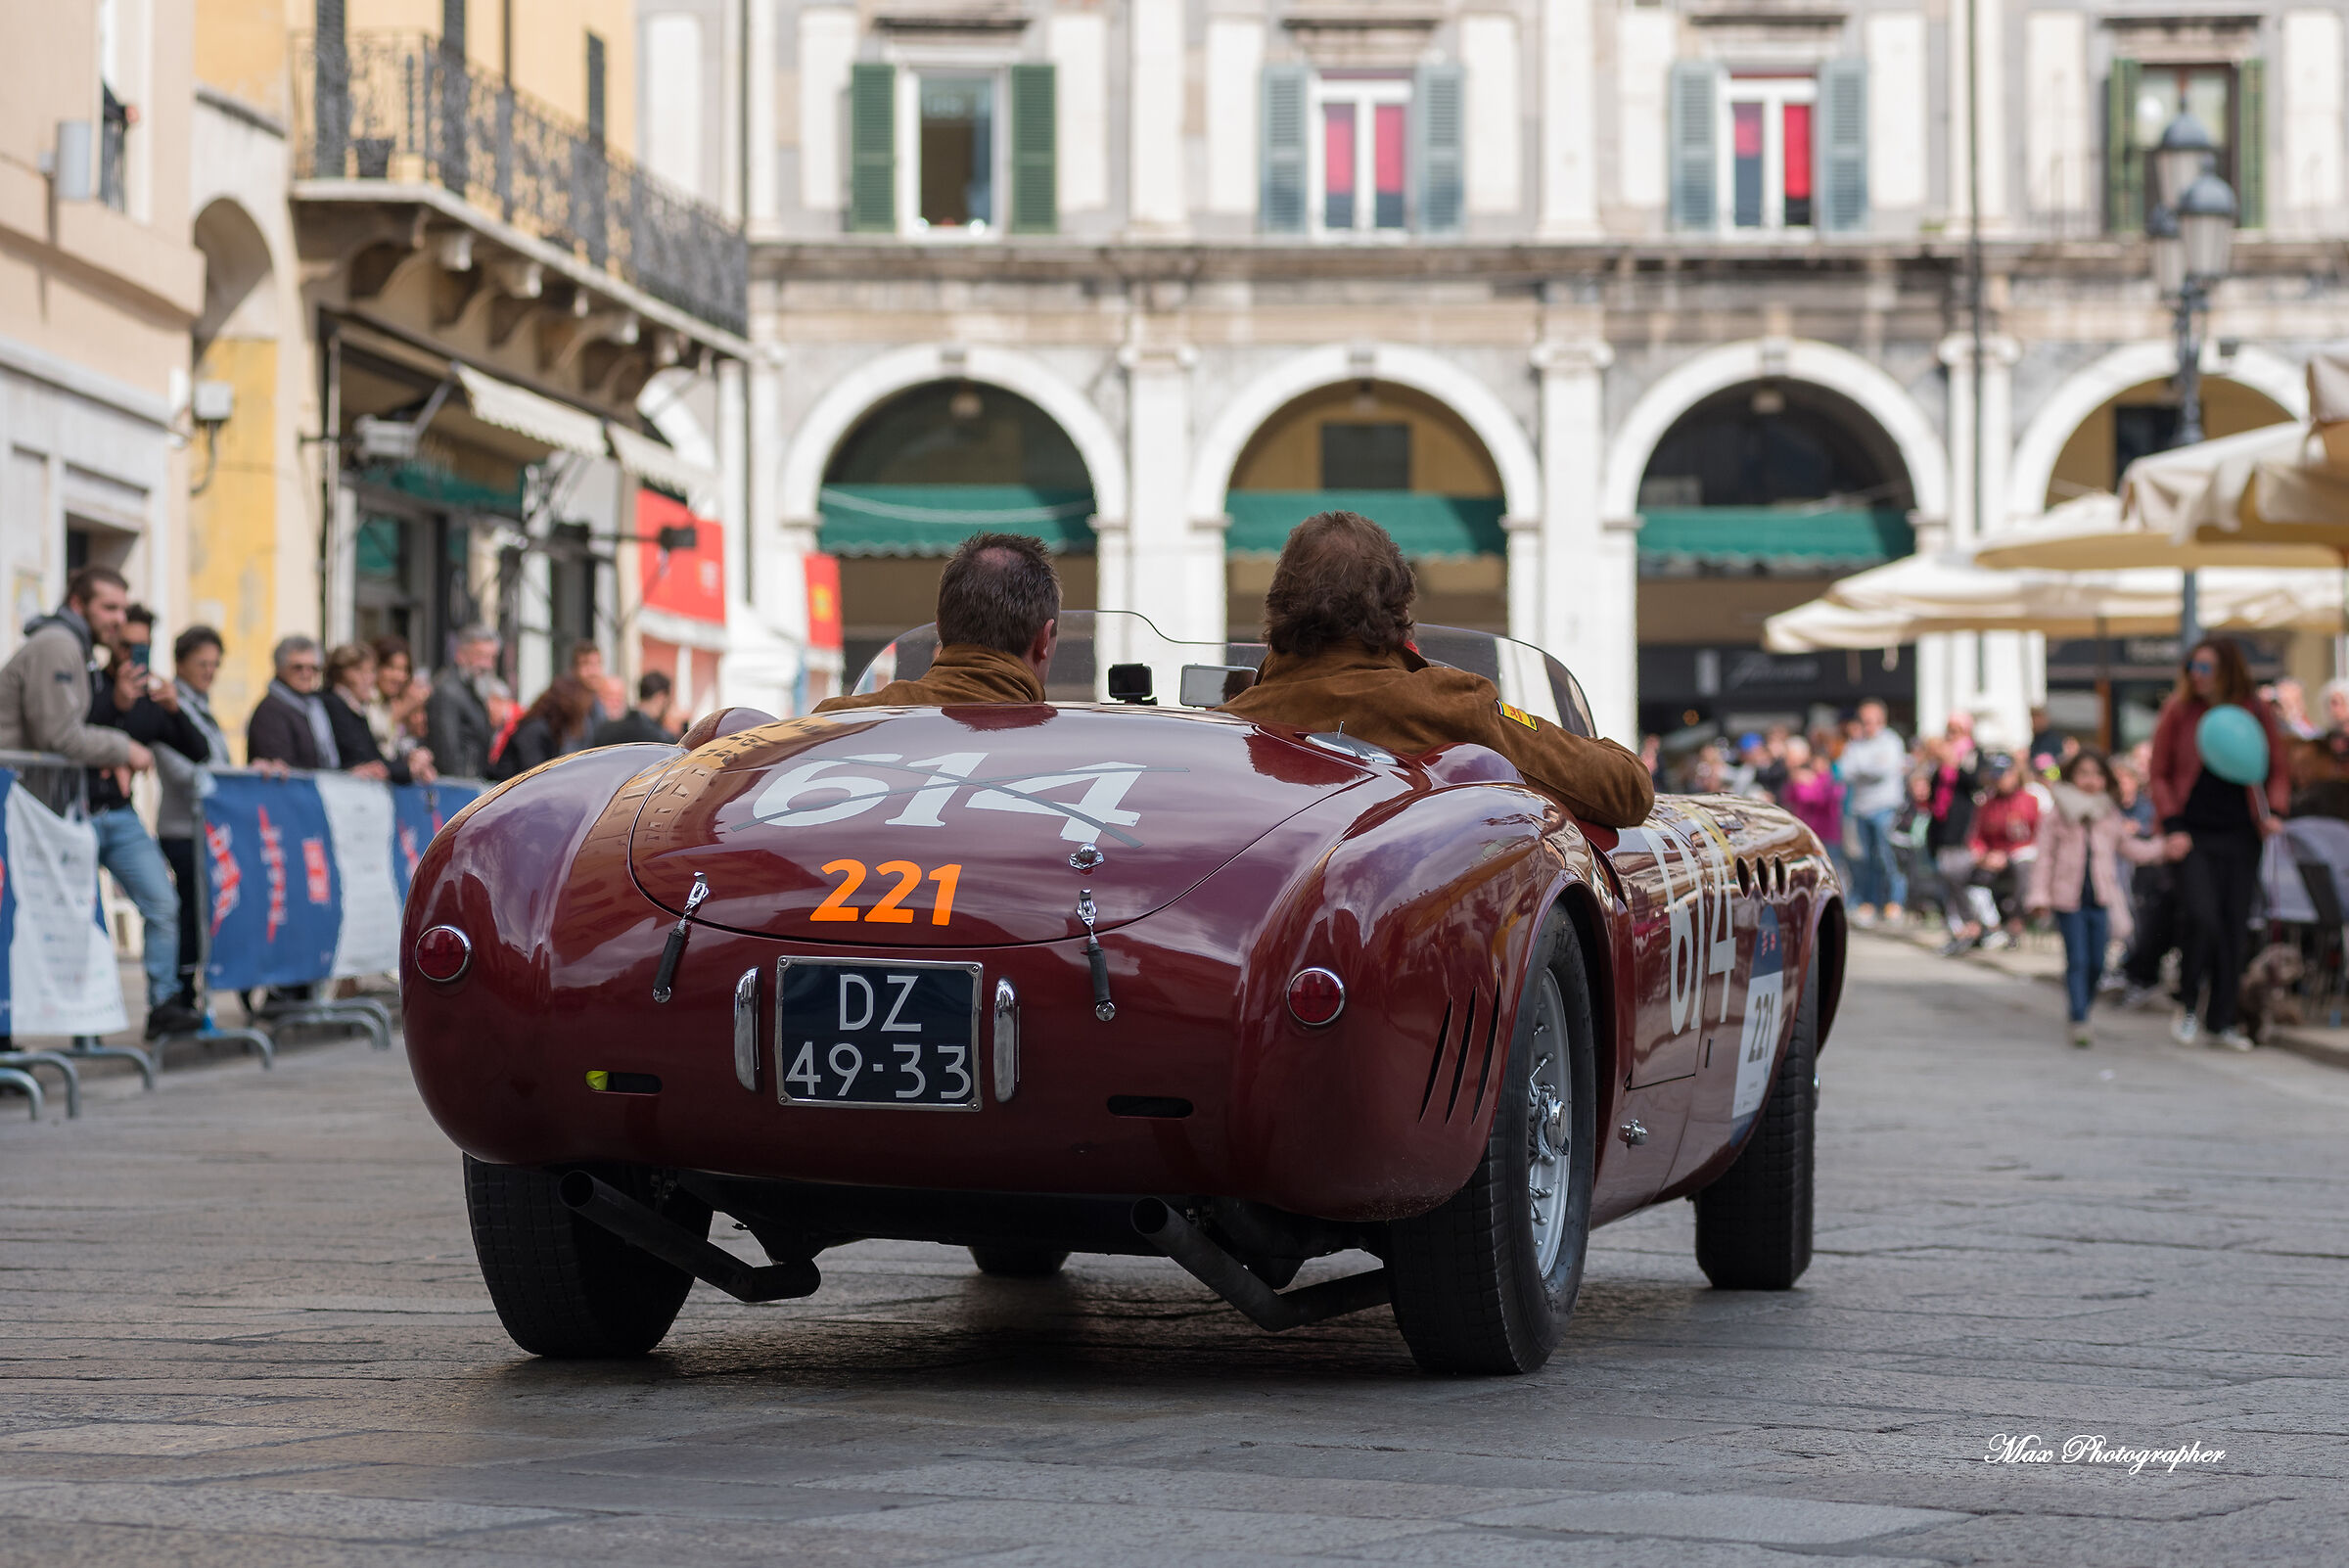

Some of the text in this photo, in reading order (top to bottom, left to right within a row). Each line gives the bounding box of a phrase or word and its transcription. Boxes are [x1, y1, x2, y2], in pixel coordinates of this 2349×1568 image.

[753, 752, 1147, 844] 614
[810, 858, 962, 927] 221
[1641, 818, 1737, 1036] 614
[840, 974, 922, 1032] DZ
[1747, 992, 1775, 1064] 221
[785, 1041, 972, 1099] 49-33
